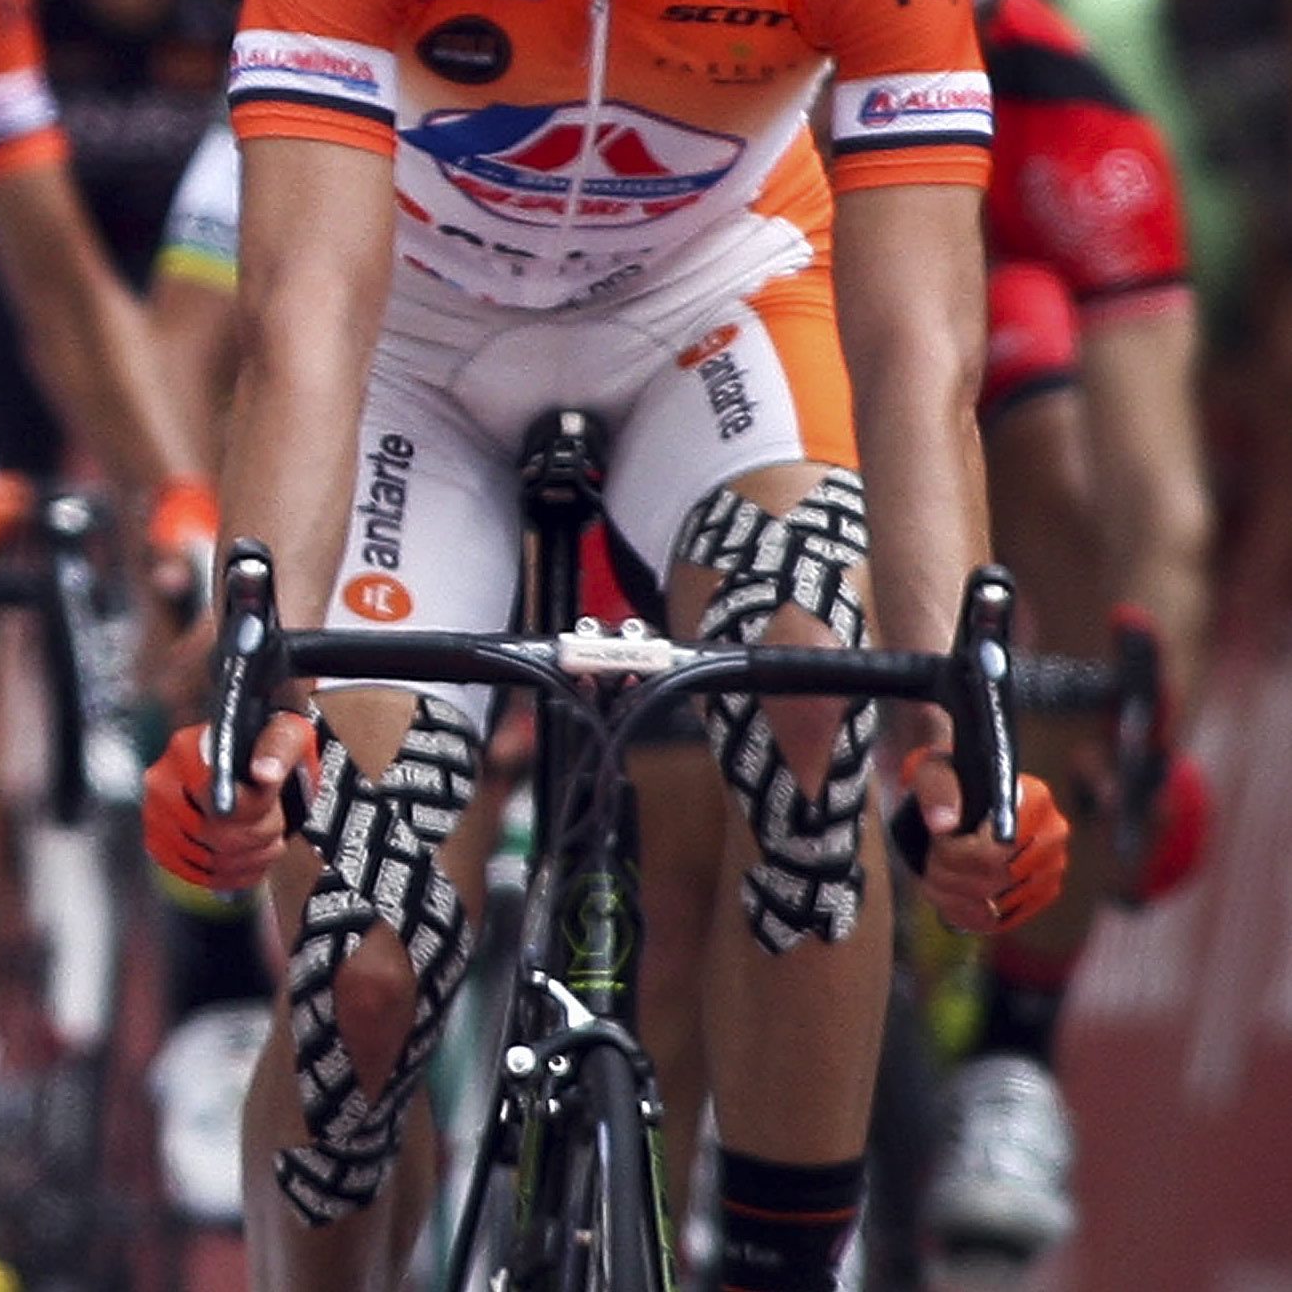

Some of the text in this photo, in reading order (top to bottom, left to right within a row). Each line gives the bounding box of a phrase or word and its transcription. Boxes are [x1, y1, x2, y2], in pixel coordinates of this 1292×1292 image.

[659, 4, 796, 28] SCOT
[696, 349, 760, 442] antarte
[362, 432, 415, 571] antarte
